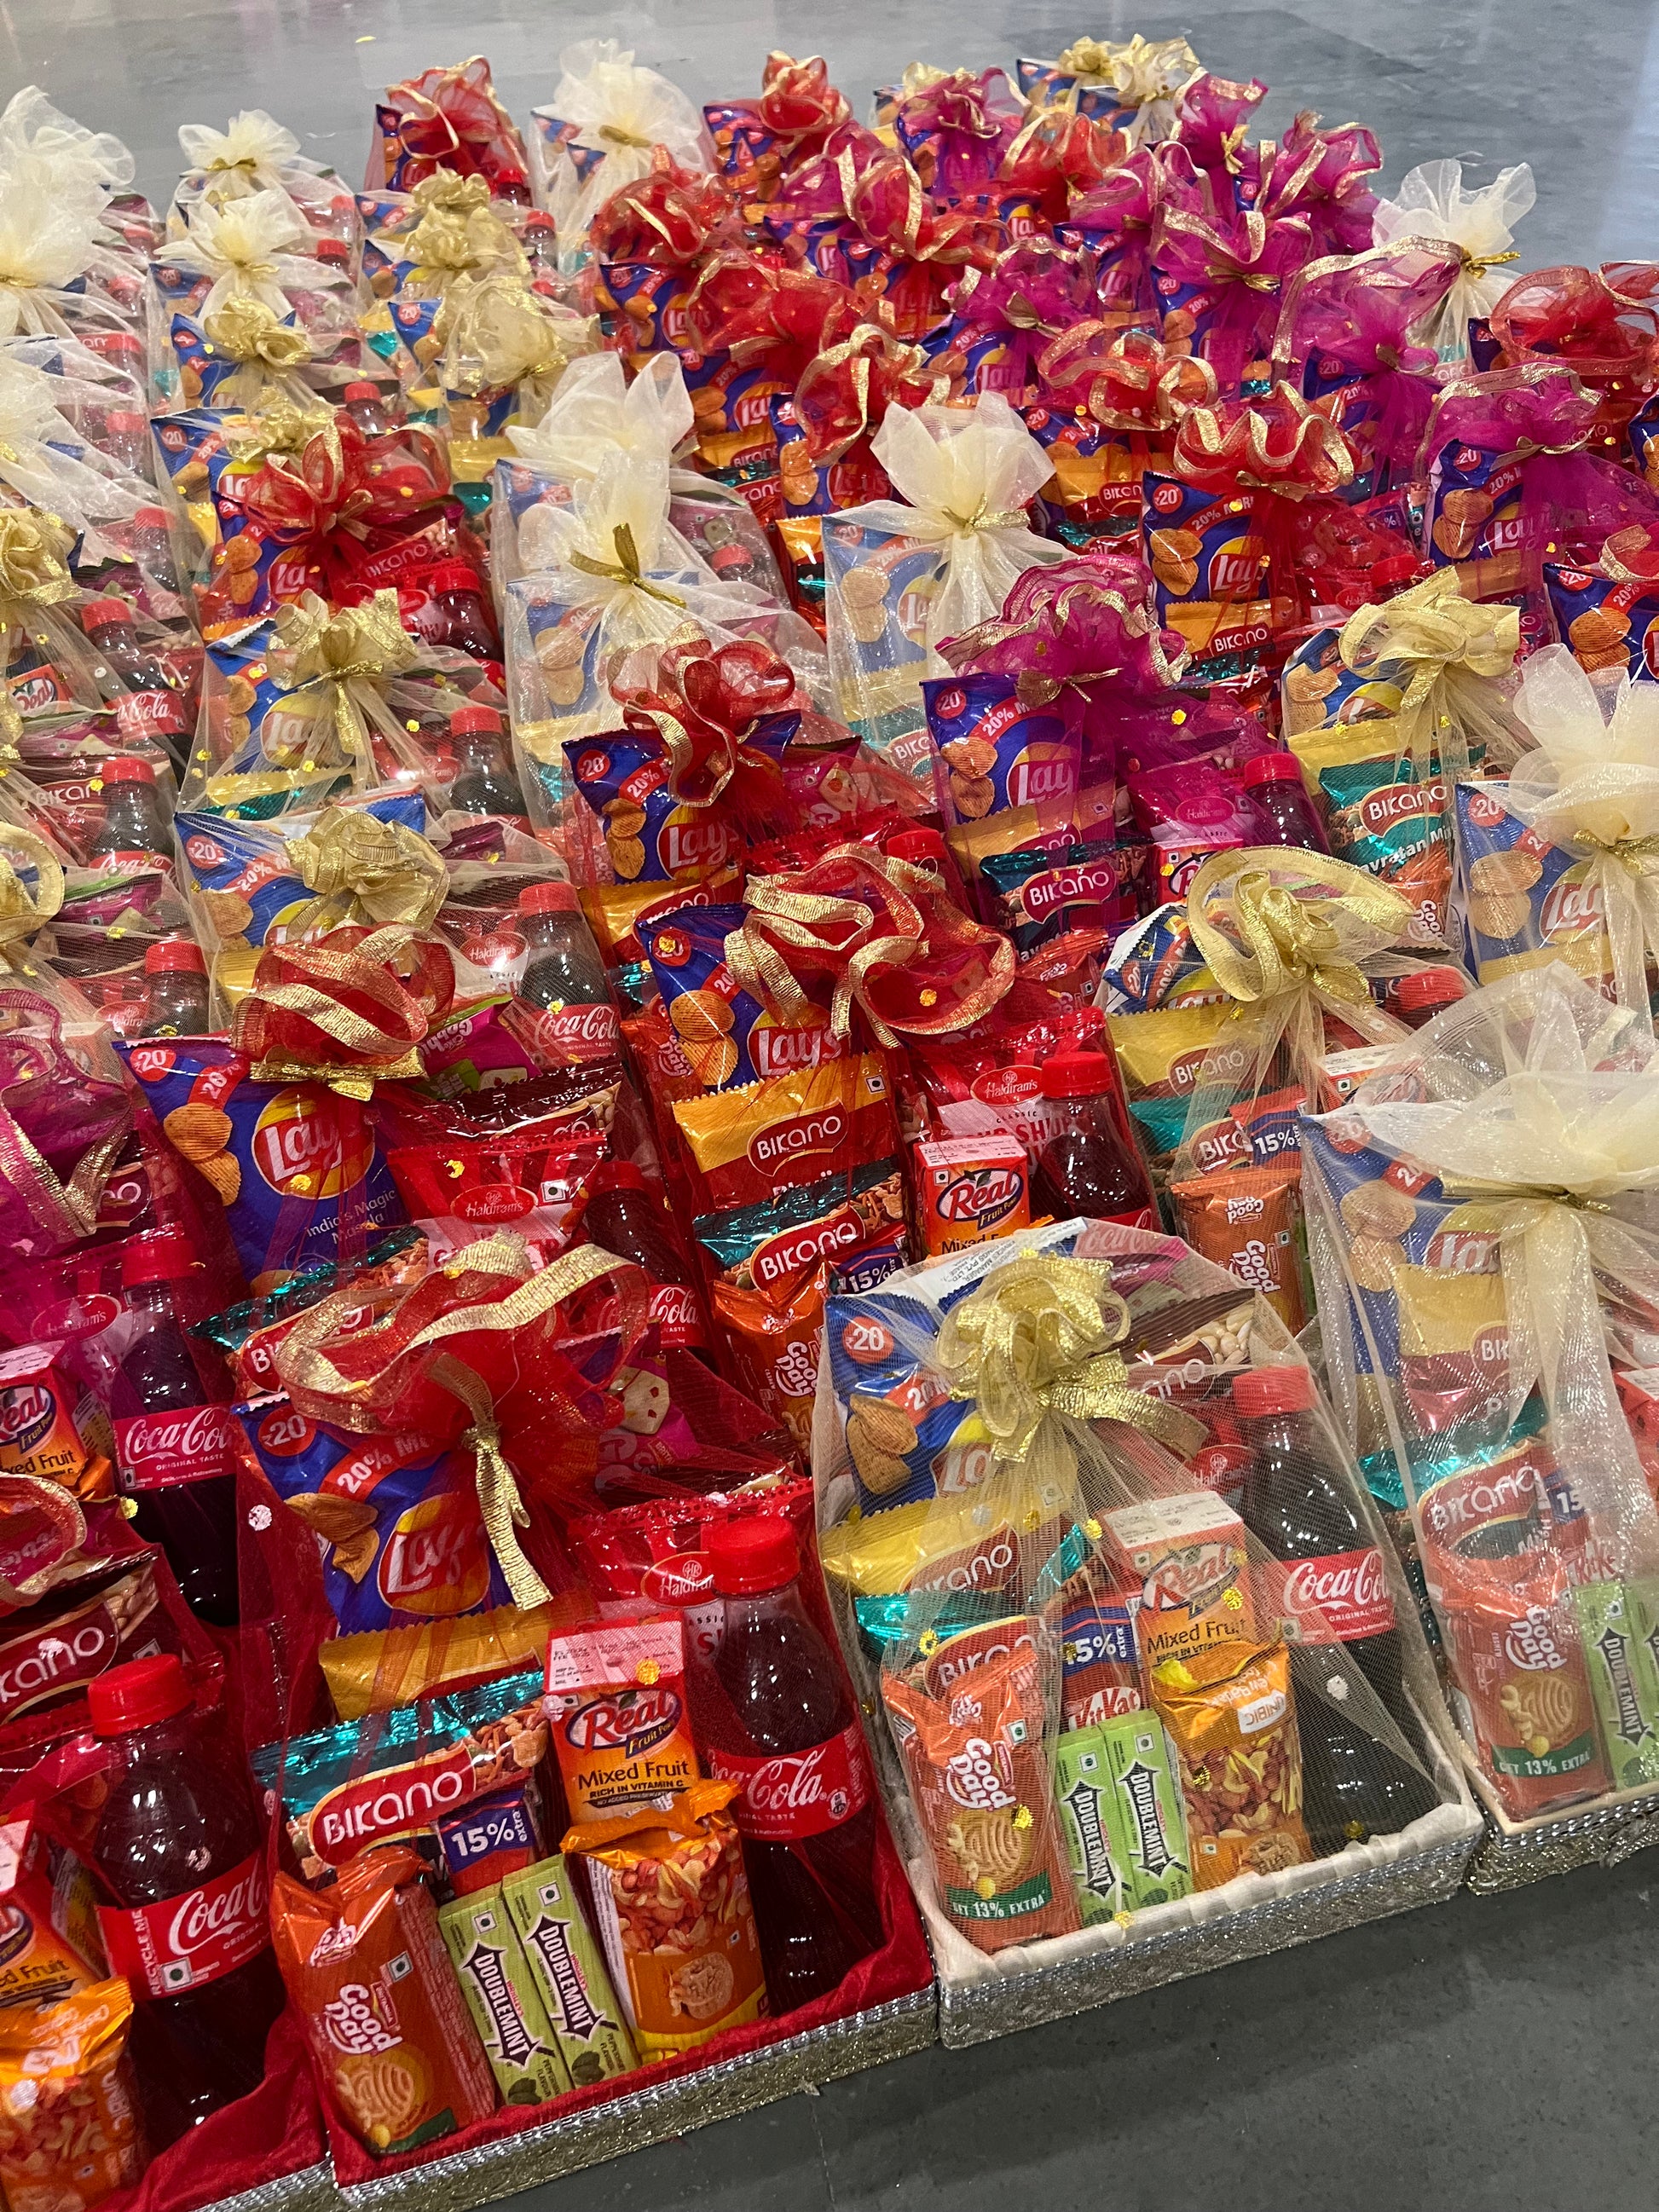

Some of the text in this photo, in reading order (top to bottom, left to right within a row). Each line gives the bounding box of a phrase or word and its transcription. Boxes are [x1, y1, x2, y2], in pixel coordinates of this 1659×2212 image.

[986, 1079, 1038, 1098] Haldiram's
[1254, 1132, 1295, 1156] 15%
[355, 1189, 396, 1214] Magic
[947, 1167, 1020, 1226] Real
[980, 1208, 1003, 1227] Fruit
[1246, 1239, 1281, 1294] Good
[38, 1450, 76, 1470] Fruit
[1329, 1611, 1369, 1623] ORIGINAL
[1147, 1622, 1199, 1654] Mixed
[582, 1689, 670, 1755] Real
[578, 1761, 690, 1790] Mixed Fruit
[966, 1738, 1016, 1809] Good
[1525, 1759, 1557, 1776] 13%
[590, 1787, 614, 1799] RICH
[617, 1784, 628, 1793] IN
[631, 1781, 673, 1793] VITAMIN
[1130, 1772, 1167, 1866] DOUBLEMINT
[451, 1817, 514, 1857] 15%
[1074, 1790, 1113, 1887] DOUBLEMINT
[973, 1900, 1005, 1919] 13%
[1009, 1895, 1045, 1915] EXTRA
[538, 1925, 592, 2032] DOUBLEMINT
[339, 1984, 403, 2056] Good
[473, 1951, 530, 2059] DOUBLEMINT
